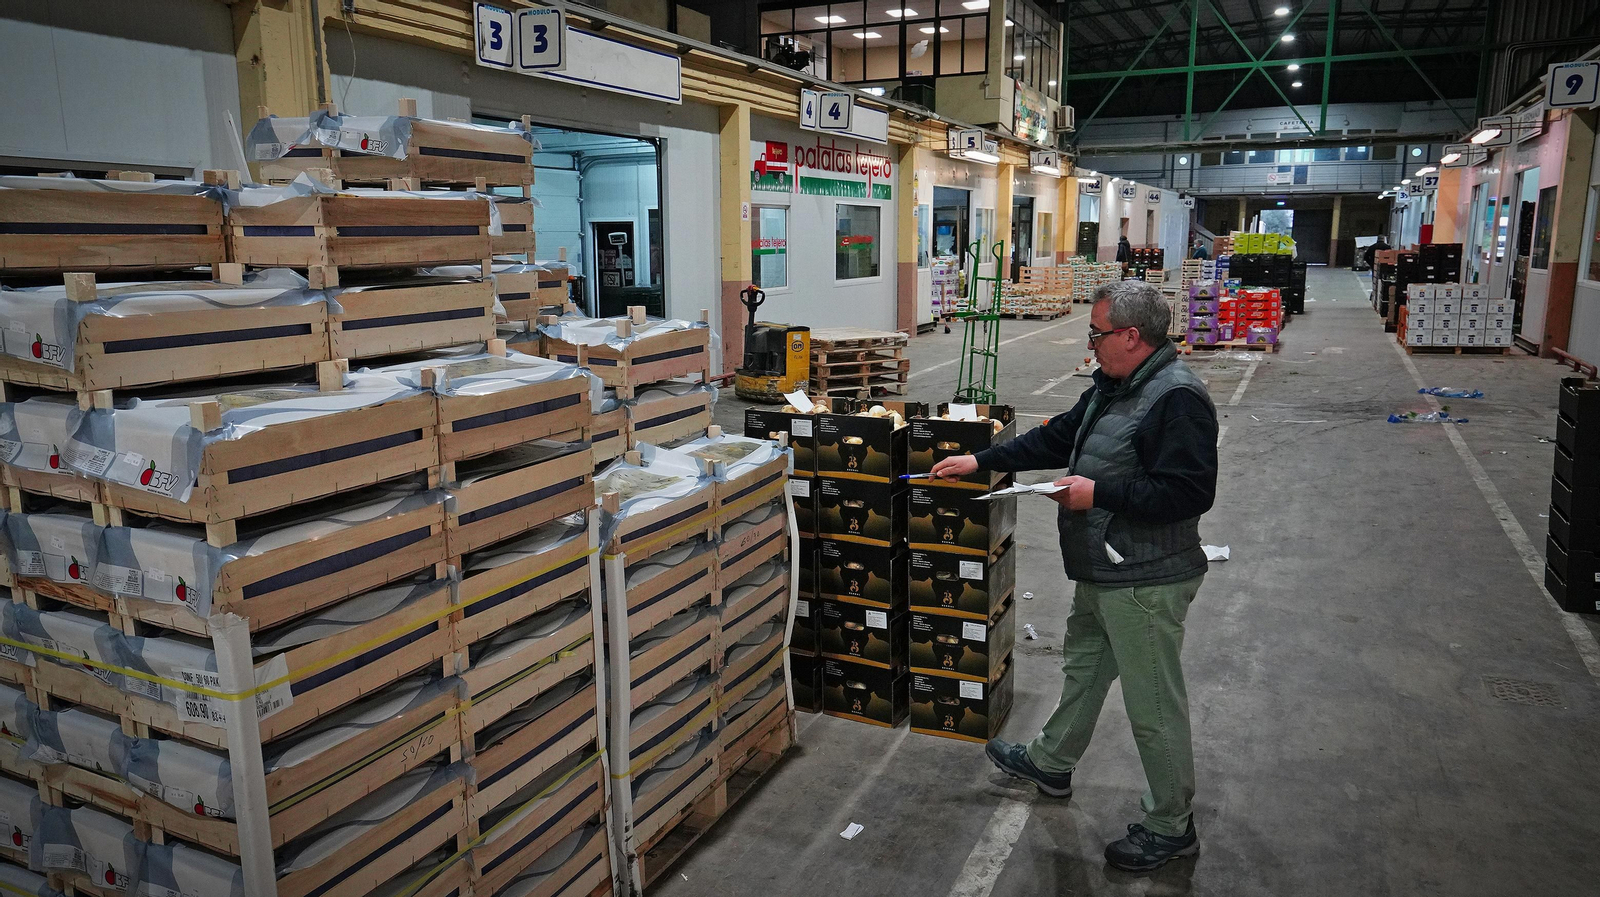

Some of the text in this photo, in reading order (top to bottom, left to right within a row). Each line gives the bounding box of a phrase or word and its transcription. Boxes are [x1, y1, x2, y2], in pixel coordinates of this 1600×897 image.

[484, 4, 506, 14] MODULO
[527, 8, 551, 16] MODULO
[490, 20, 503, 50] 3
[533, 24, 548, 54] 3
[1565, 74, 1584, 96] 9
[806, 101, 813, 119] 4
[828, 102, 841, 121] 4
[367, 140, 388, 152] BFV
[967, 136, 976, 149] 5
[794, 136, 892, 199] patatas tejero
[1425, 176, 1439, 186] 37
[41, 342, 66, 363] BFV
[149, 469, 180, 491] BFV
